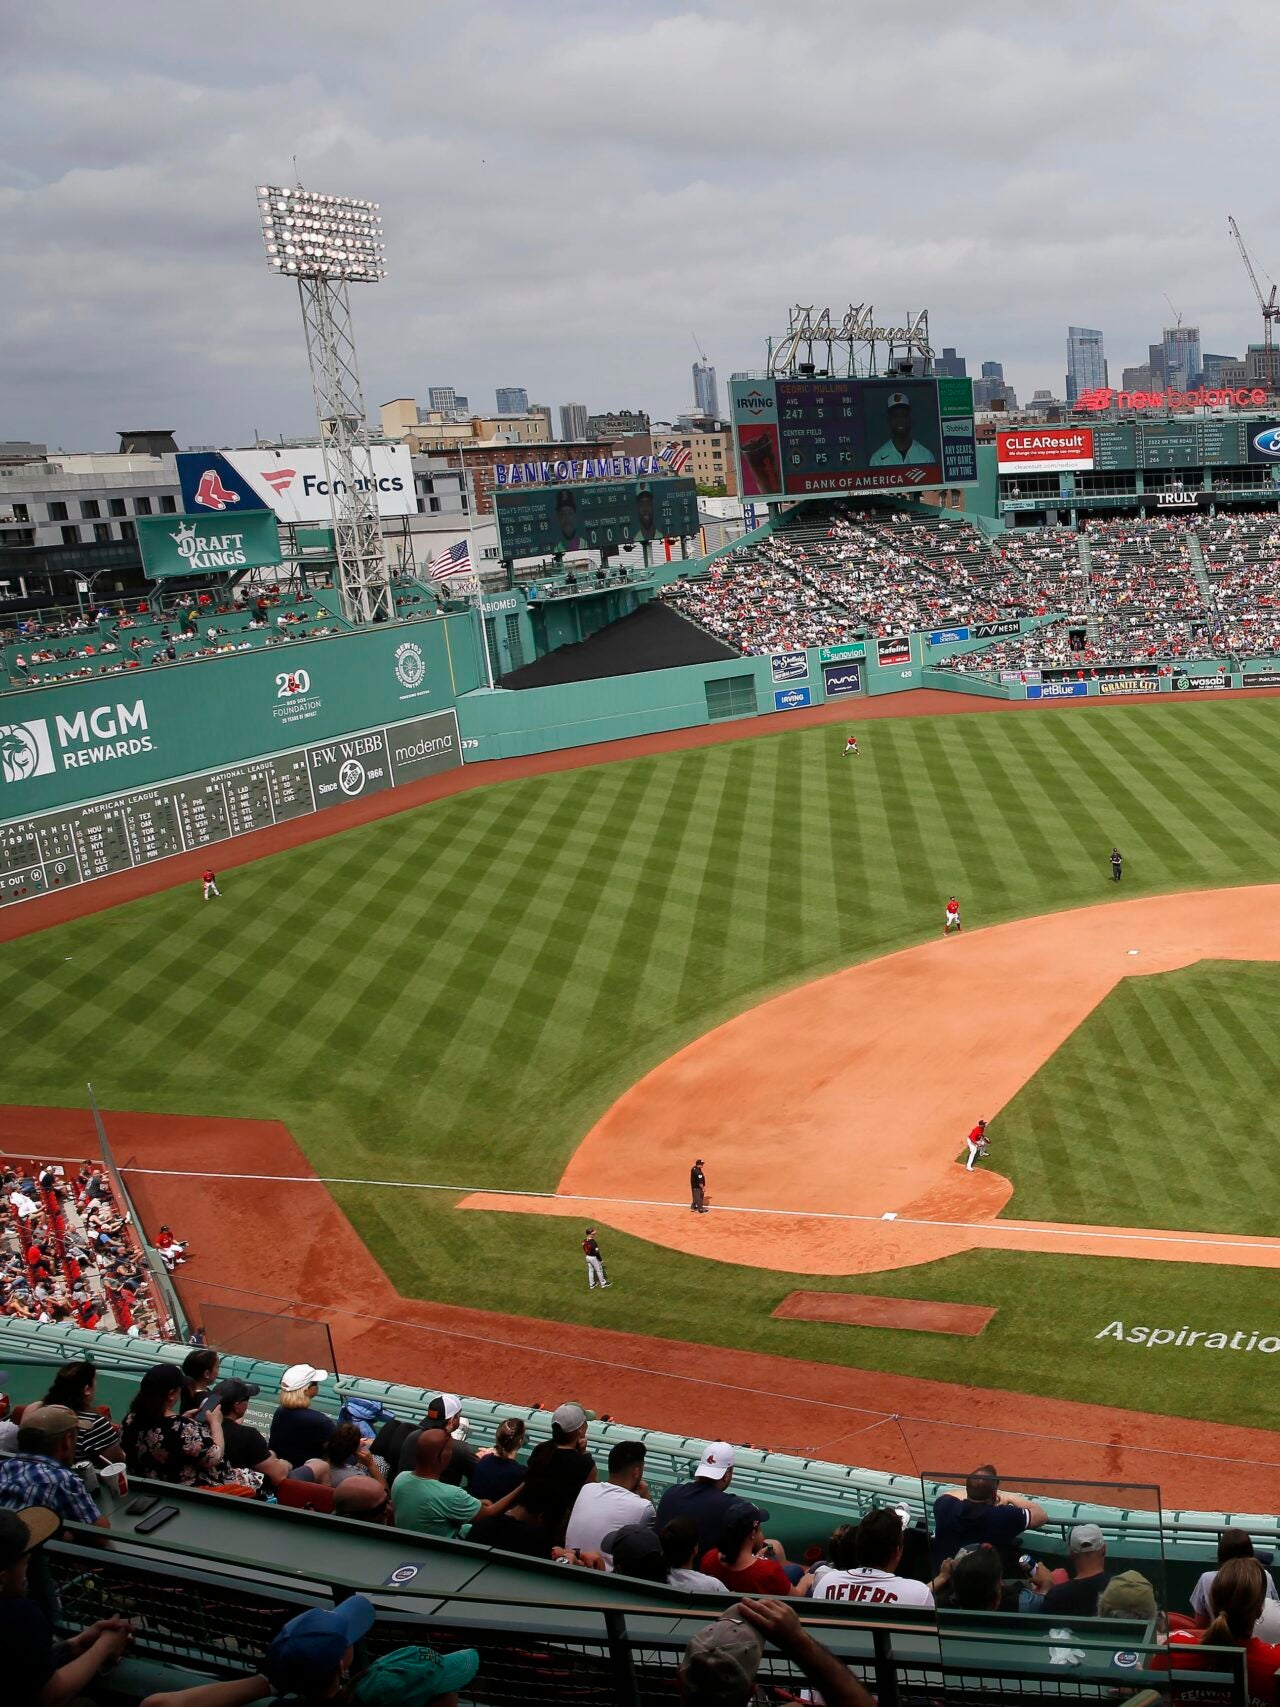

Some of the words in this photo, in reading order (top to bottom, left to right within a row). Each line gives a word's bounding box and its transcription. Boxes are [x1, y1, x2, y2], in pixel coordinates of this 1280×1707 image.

[780, 385, 809, 394] CEDRIC
[813, 384, 848, 393] MULLINS
[787, 397, 798, 405] AVG
[1117, 392, 1164, 410] new
[1168, 384, 1267, 408] balance
[738, 398, 773, 408] IRVING
[782, 409, 803, 420] .247
[818, 409, 824, 418] 5
[842, 408, 852, 417] 16
[783, 429, 805, 437] CENTER
[946, 424, 969, 434] StubHub
[1006, 436, 1083, 450] CLEAResult
[816, 453, 827, 463] P5
[840, 452, 852, 461] FC
[493, 462, 550, 485] BANK
[554, 460, 579, 481] OF
[583, 456, 660, 478] AMERICA
[805, 479, 837, 490] BANK
[838, 478, 853, 488] OF
[854, 475, 904, 486] AMERICA
[1156, 492, 1197, 504] TRULY
[505, 526, 514, 534] 93
[523, 524, 532, 532] 64
[540, 522, 548, 531] 69
[591, 531, 597, 544] 0
[607, 529, 613, 541] 0
[623, 526, 629, 539] 0
[177, 533, 243, 558] DRAFT
[188, 549, 246, 569] KINGS
[482, 598, 516, 612] ABIOMED
[998, 624, 1019, 632] NESN
[394, 642, 411, 658] IBEW
[831, 649, 864, 660] sunovion
[879, 646, 908, 655] Safelite
[275, 669, 311, 699] 20
[828, 674, 856, 686] nuna
[1190, 676, 1225, 686] wasabi
[1041, 685, 1073, 697] jetBlue
[1102, 680, 1138, 693] GRANITE
[1140, 680, 1159, 690] CITY
[782, 694, 804, 703] IRVING
[272, 700, 322, 718] FOUNDATION
[56, 700, 148, 748] MGM
[395, 734, 453, 762] moderna
[462, 739, 479, 749] 379
[63, 735, 153, 770] REWARDS
[312, 746, 337, 768] F.W.
[340, 734, 383, 759] WEBB
[210, 769, 246, 783] NATIONAL
[247, 762, 274, 774] LEAGUE
[318, 781, 338, 794] Since
[366, 768, 384, 780] 1866
[238, 786, 249, 794] LAD
[82, 800, 125, 816] AMERICAN
[128, 790, 159, 804] LEAGUE
[139, 812, 152, 821] TEX
[195, 812, 206, 821] COL
[241, 807, 252, 815] STL
[87, 826, 102, 834] HOU
[245, 821, 255, 829] ATL
[90, 833, 102, 842] SEA
[142, 828, 154, 836] TOR
[143, 835, 156, 843] LAA
[91, 841, 104, 850] NYY
[146, 843, 156, 851] KC
[147, 850, 158, 858] MIN
[94, 857, 108, 866] CLE
[96, 864, 109, 874] DET
[8, 875, 25, 886] OUT
